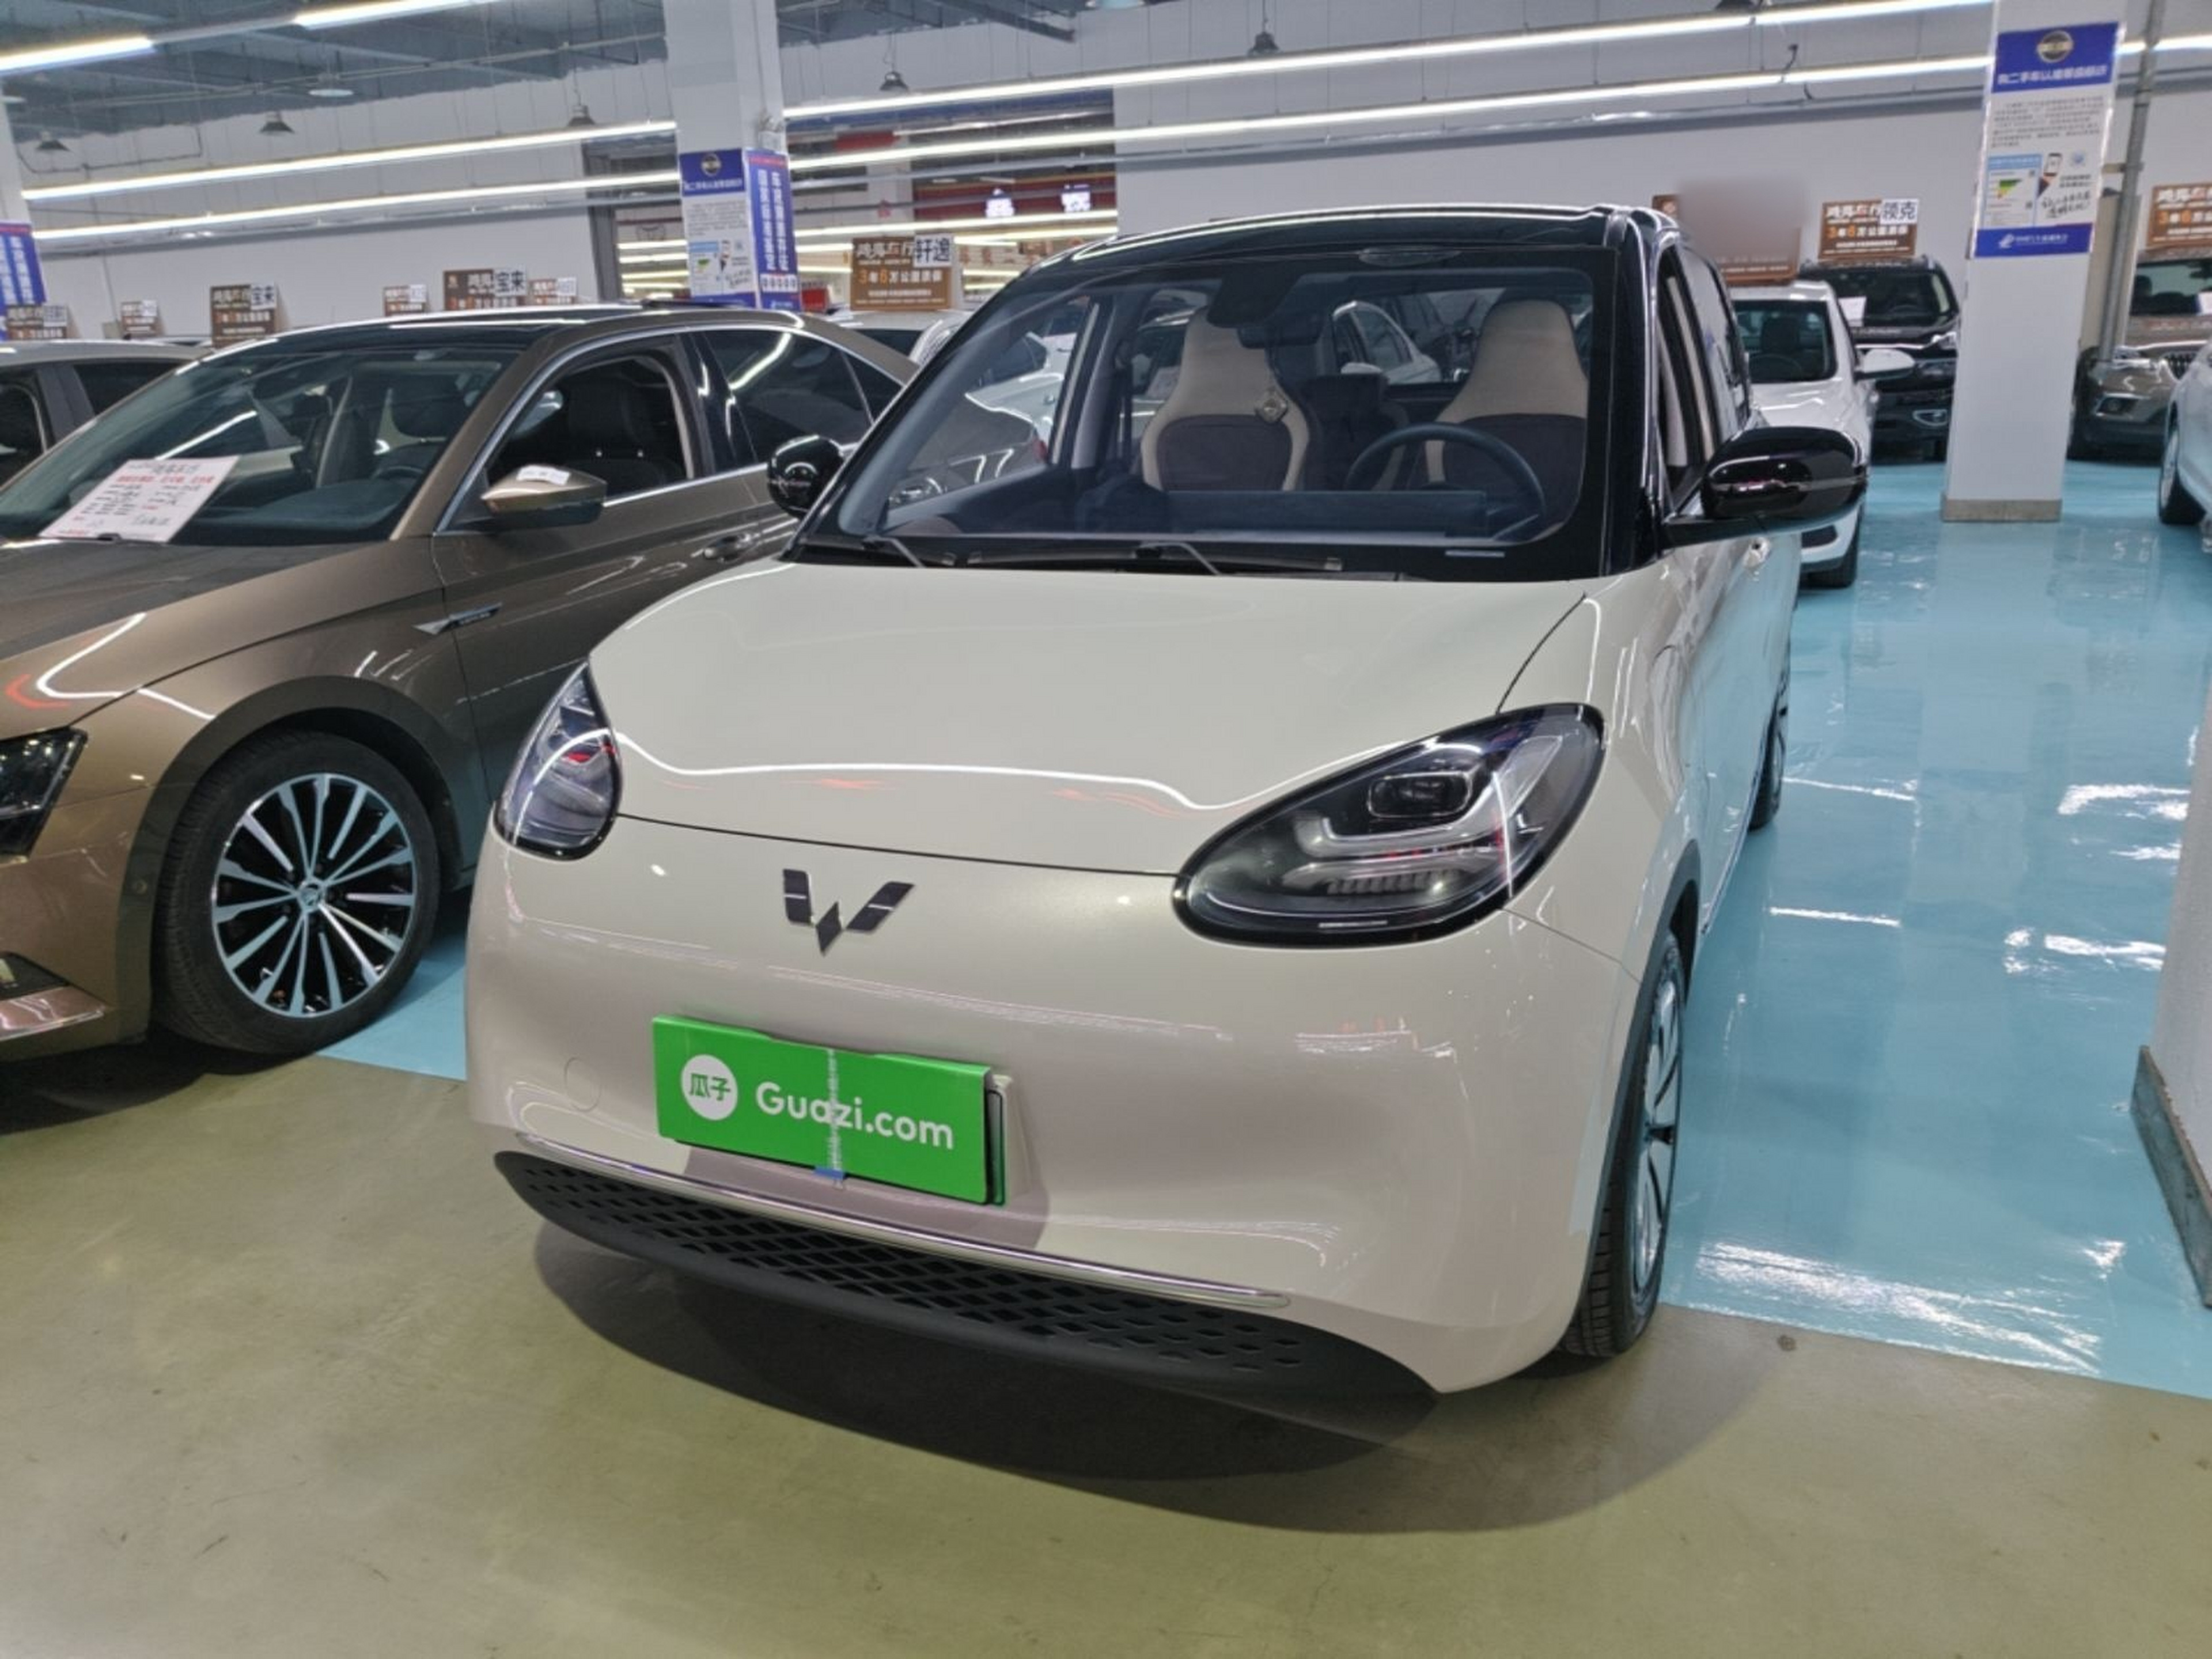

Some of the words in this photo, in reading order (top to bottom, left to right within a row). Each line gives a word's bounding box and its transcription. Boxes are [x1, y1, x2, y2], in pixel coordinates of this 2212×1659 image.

[916, 238, 950, 263] 轩逸
[689, 1072, 731, 1101] 瓜子
[755, 1081, 955, 1150] Guazi.com
